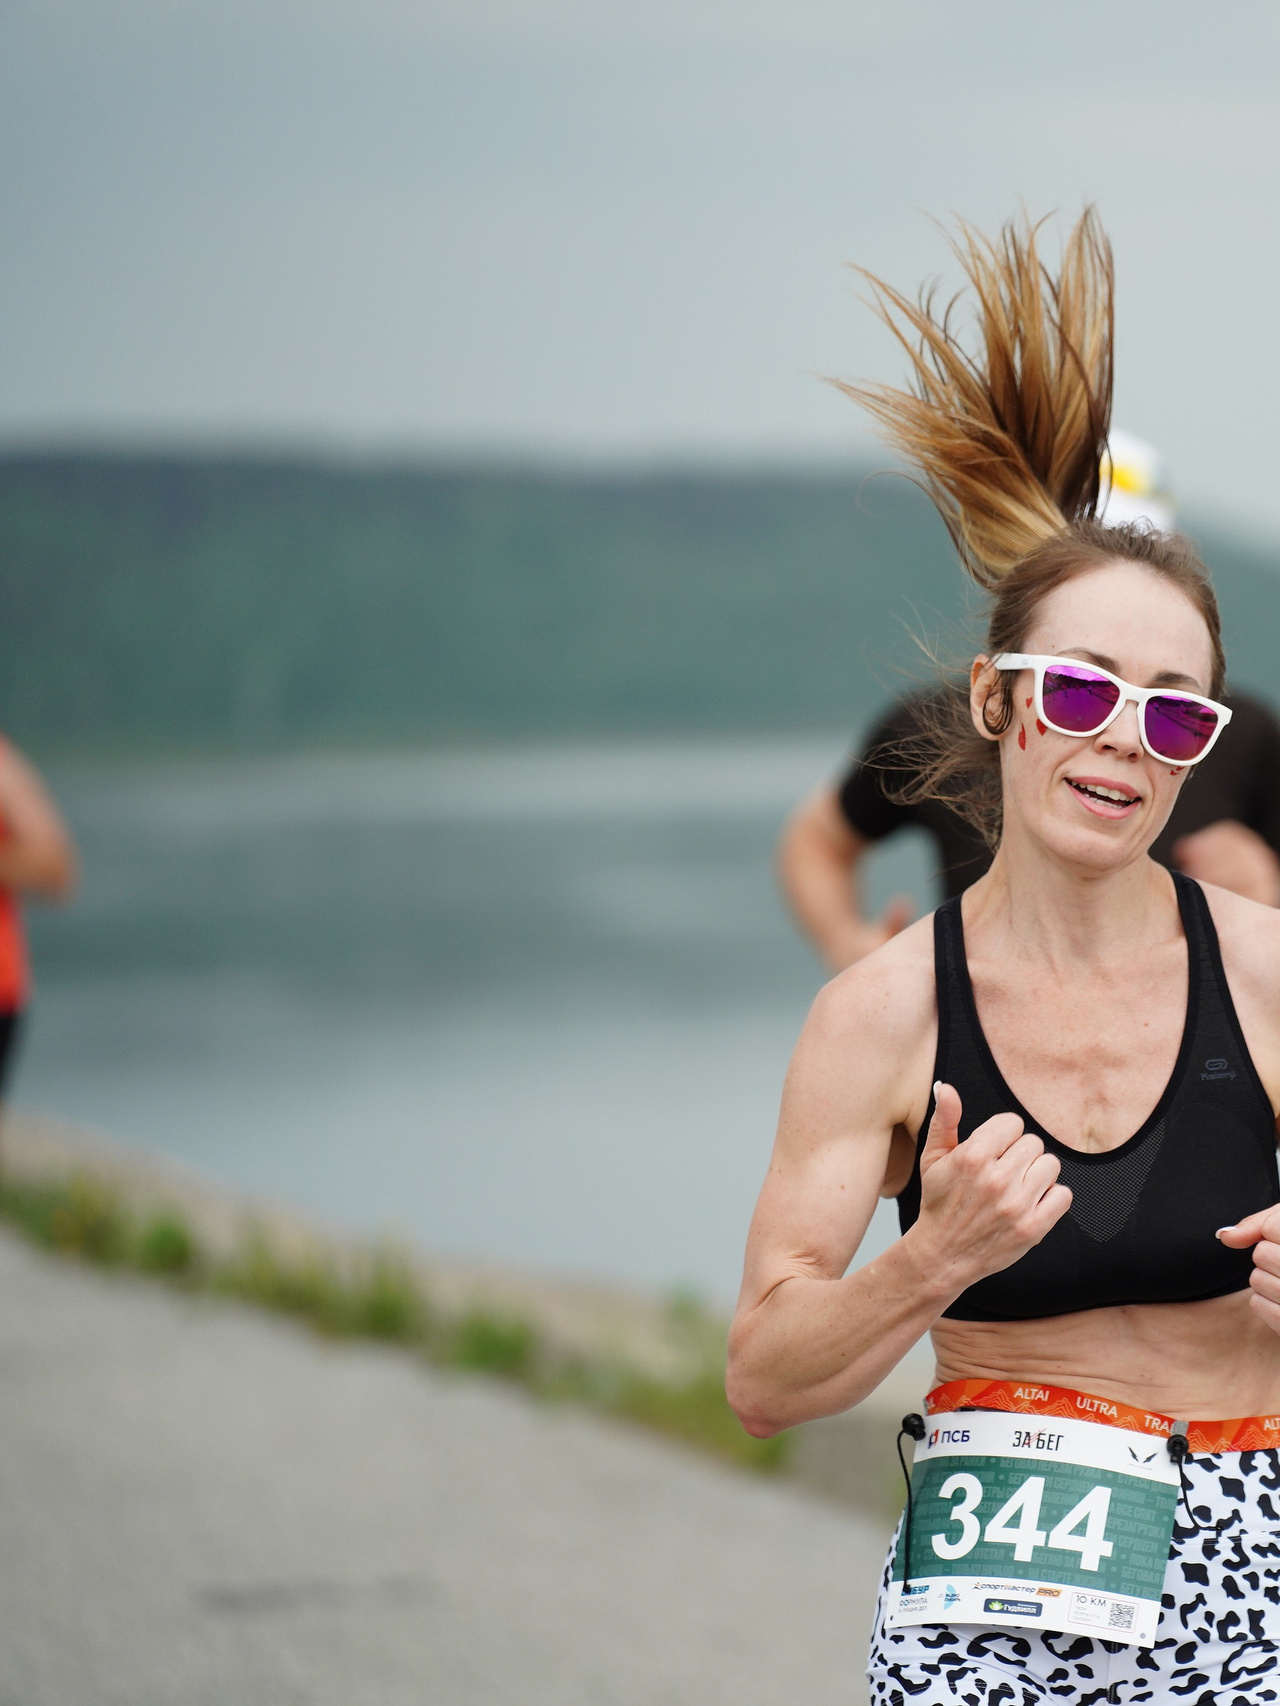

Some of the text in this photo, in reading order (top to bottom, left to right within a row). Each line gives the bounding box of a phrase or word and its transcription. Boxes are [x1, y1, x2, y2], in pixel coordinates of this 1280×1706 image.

[1014, 1387, 1049, 1402] ALTAI
[1076, 1396, 1119, 1418] ULTRA
[941, 1429, 970, 1444] ПСБ
[931, 1472, 1114, 1572] 344
[1037, 1587, 1060, 1598] PRO
[1076, 1594, 1088, 1604] 10
